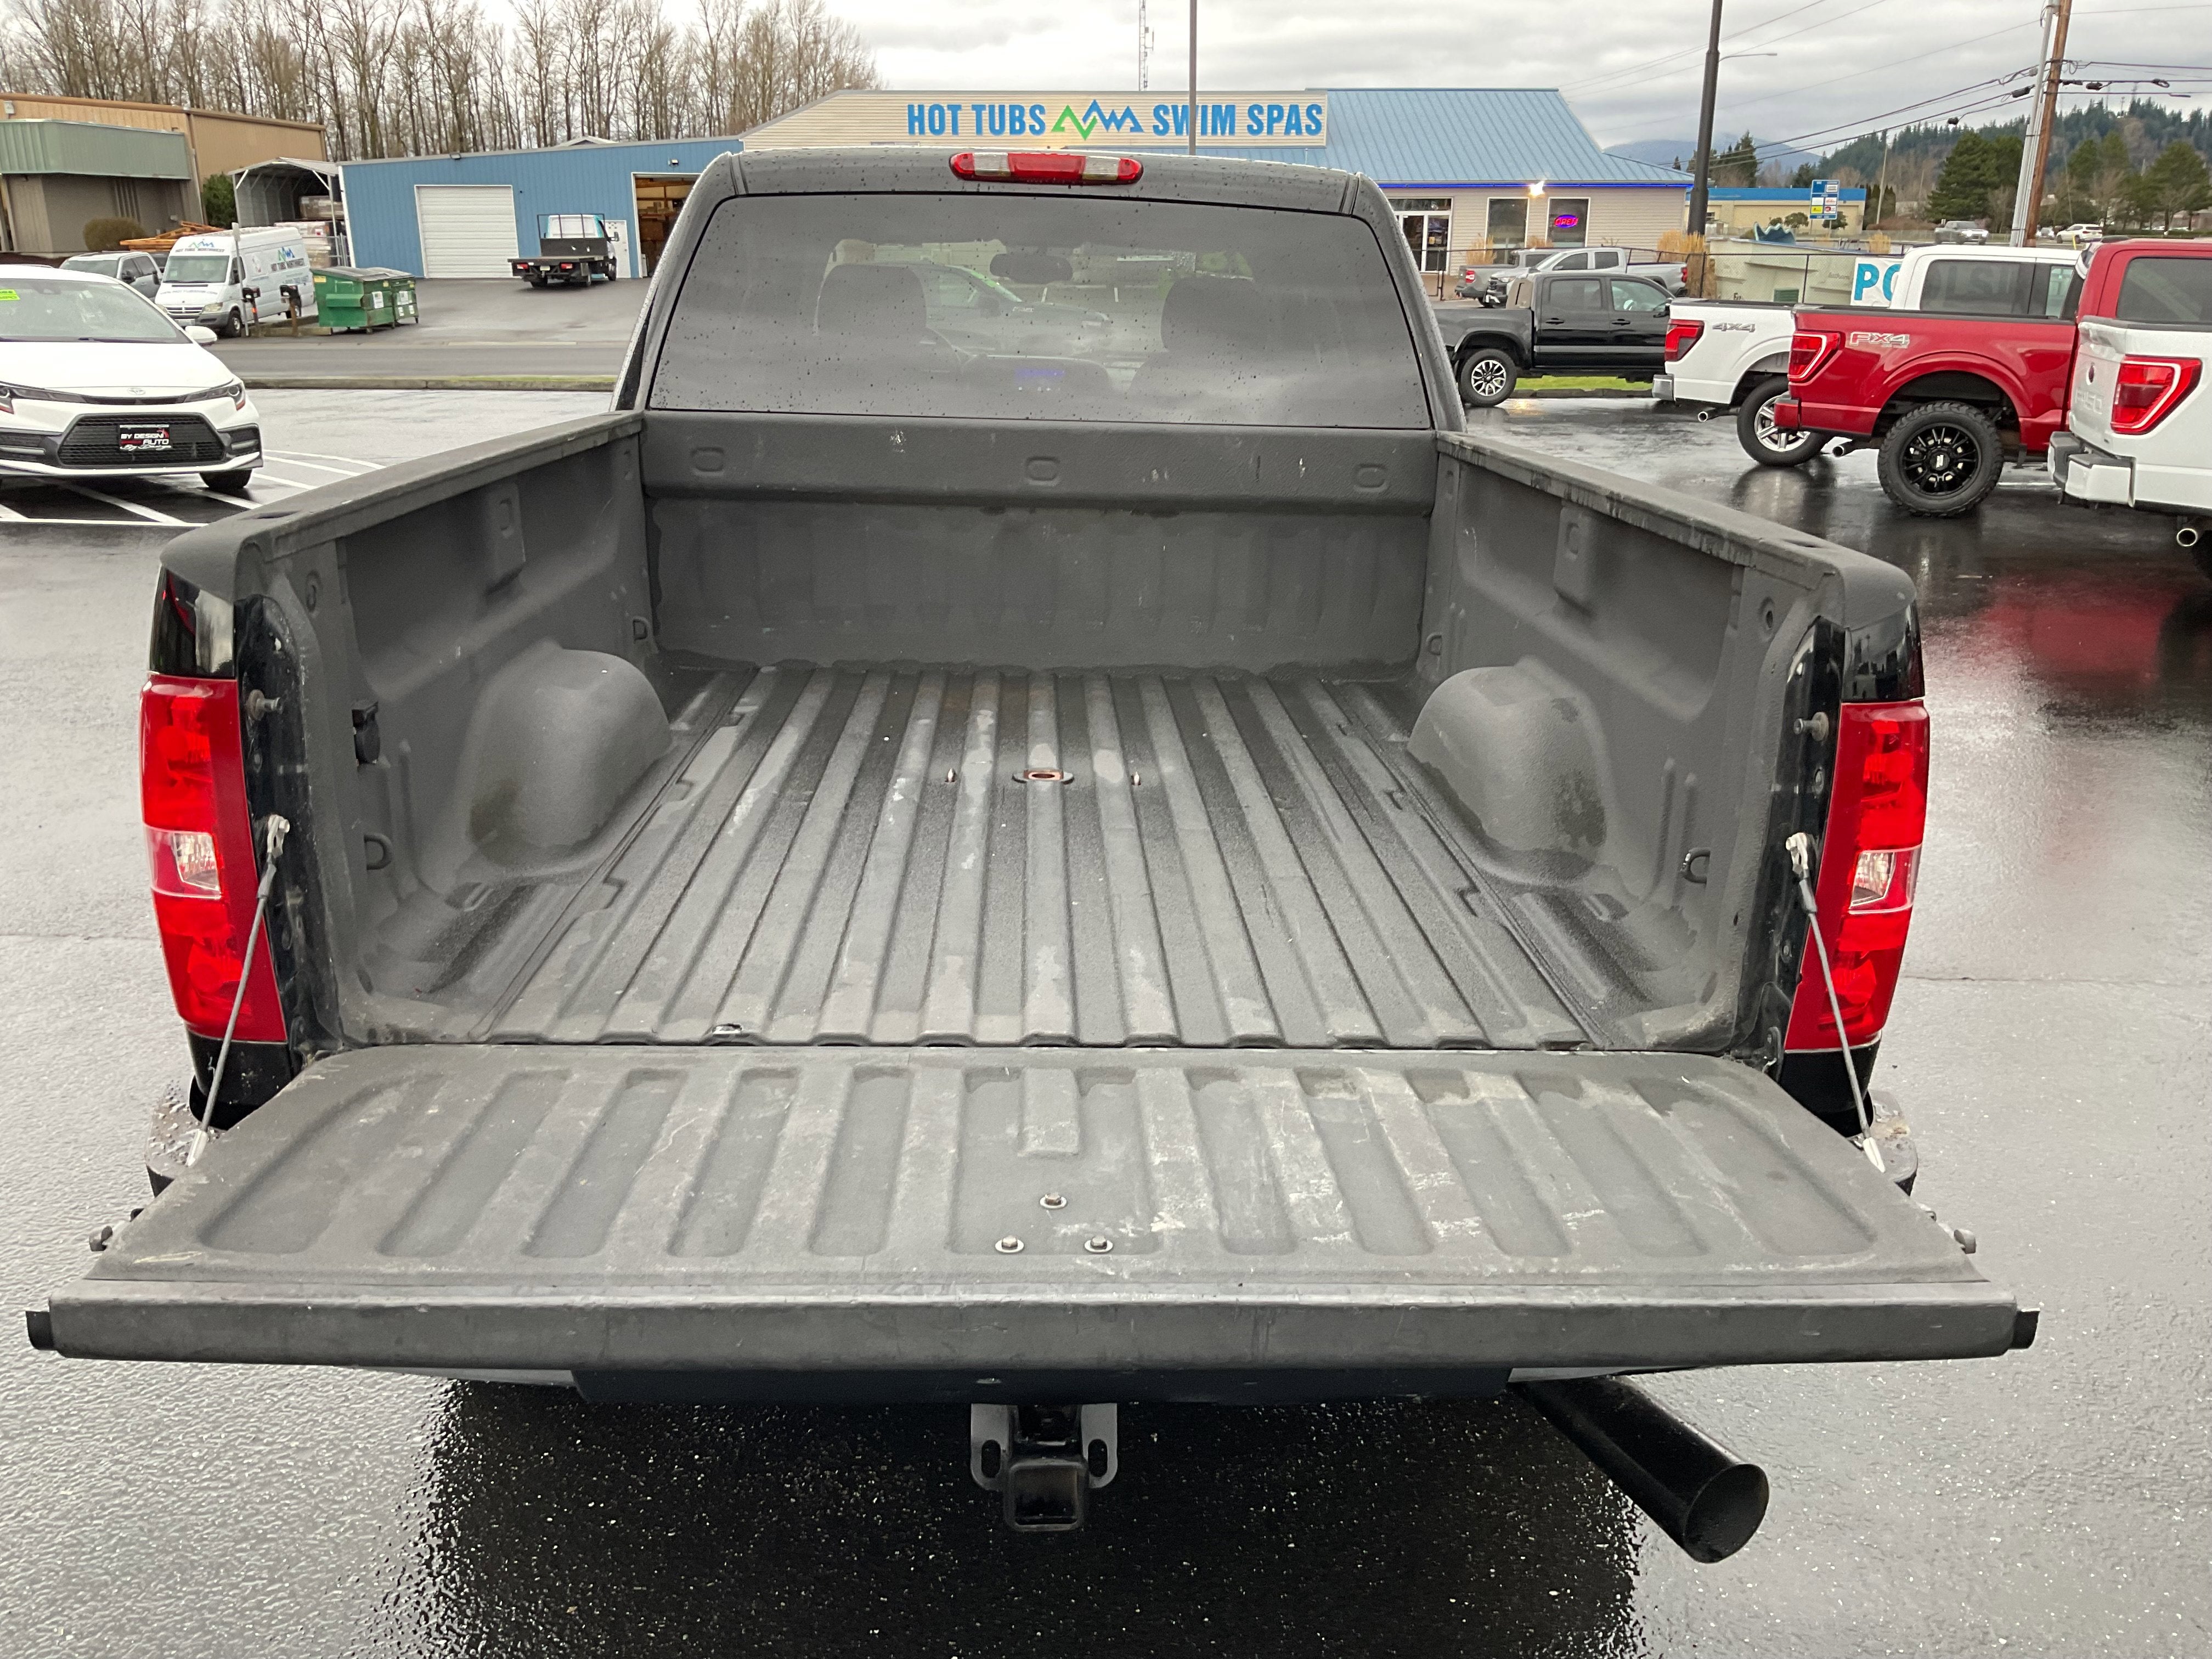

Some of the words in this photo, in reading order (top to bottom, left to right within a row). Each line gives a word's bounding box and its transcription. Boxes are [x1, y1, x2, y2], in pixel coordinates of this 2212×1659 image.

[907, 104, 962, 136] HOT
[971, 104, 1046, 136] TUBS
[1153, 104, 1235, 136] SWIM
[1247, 104, 1322, 136] SPAS
[1554, 217, 1578, 225] OPEN
[1712, 323, 1756, 332] 4X4
[1849, 331, 1910, 348] FX4
